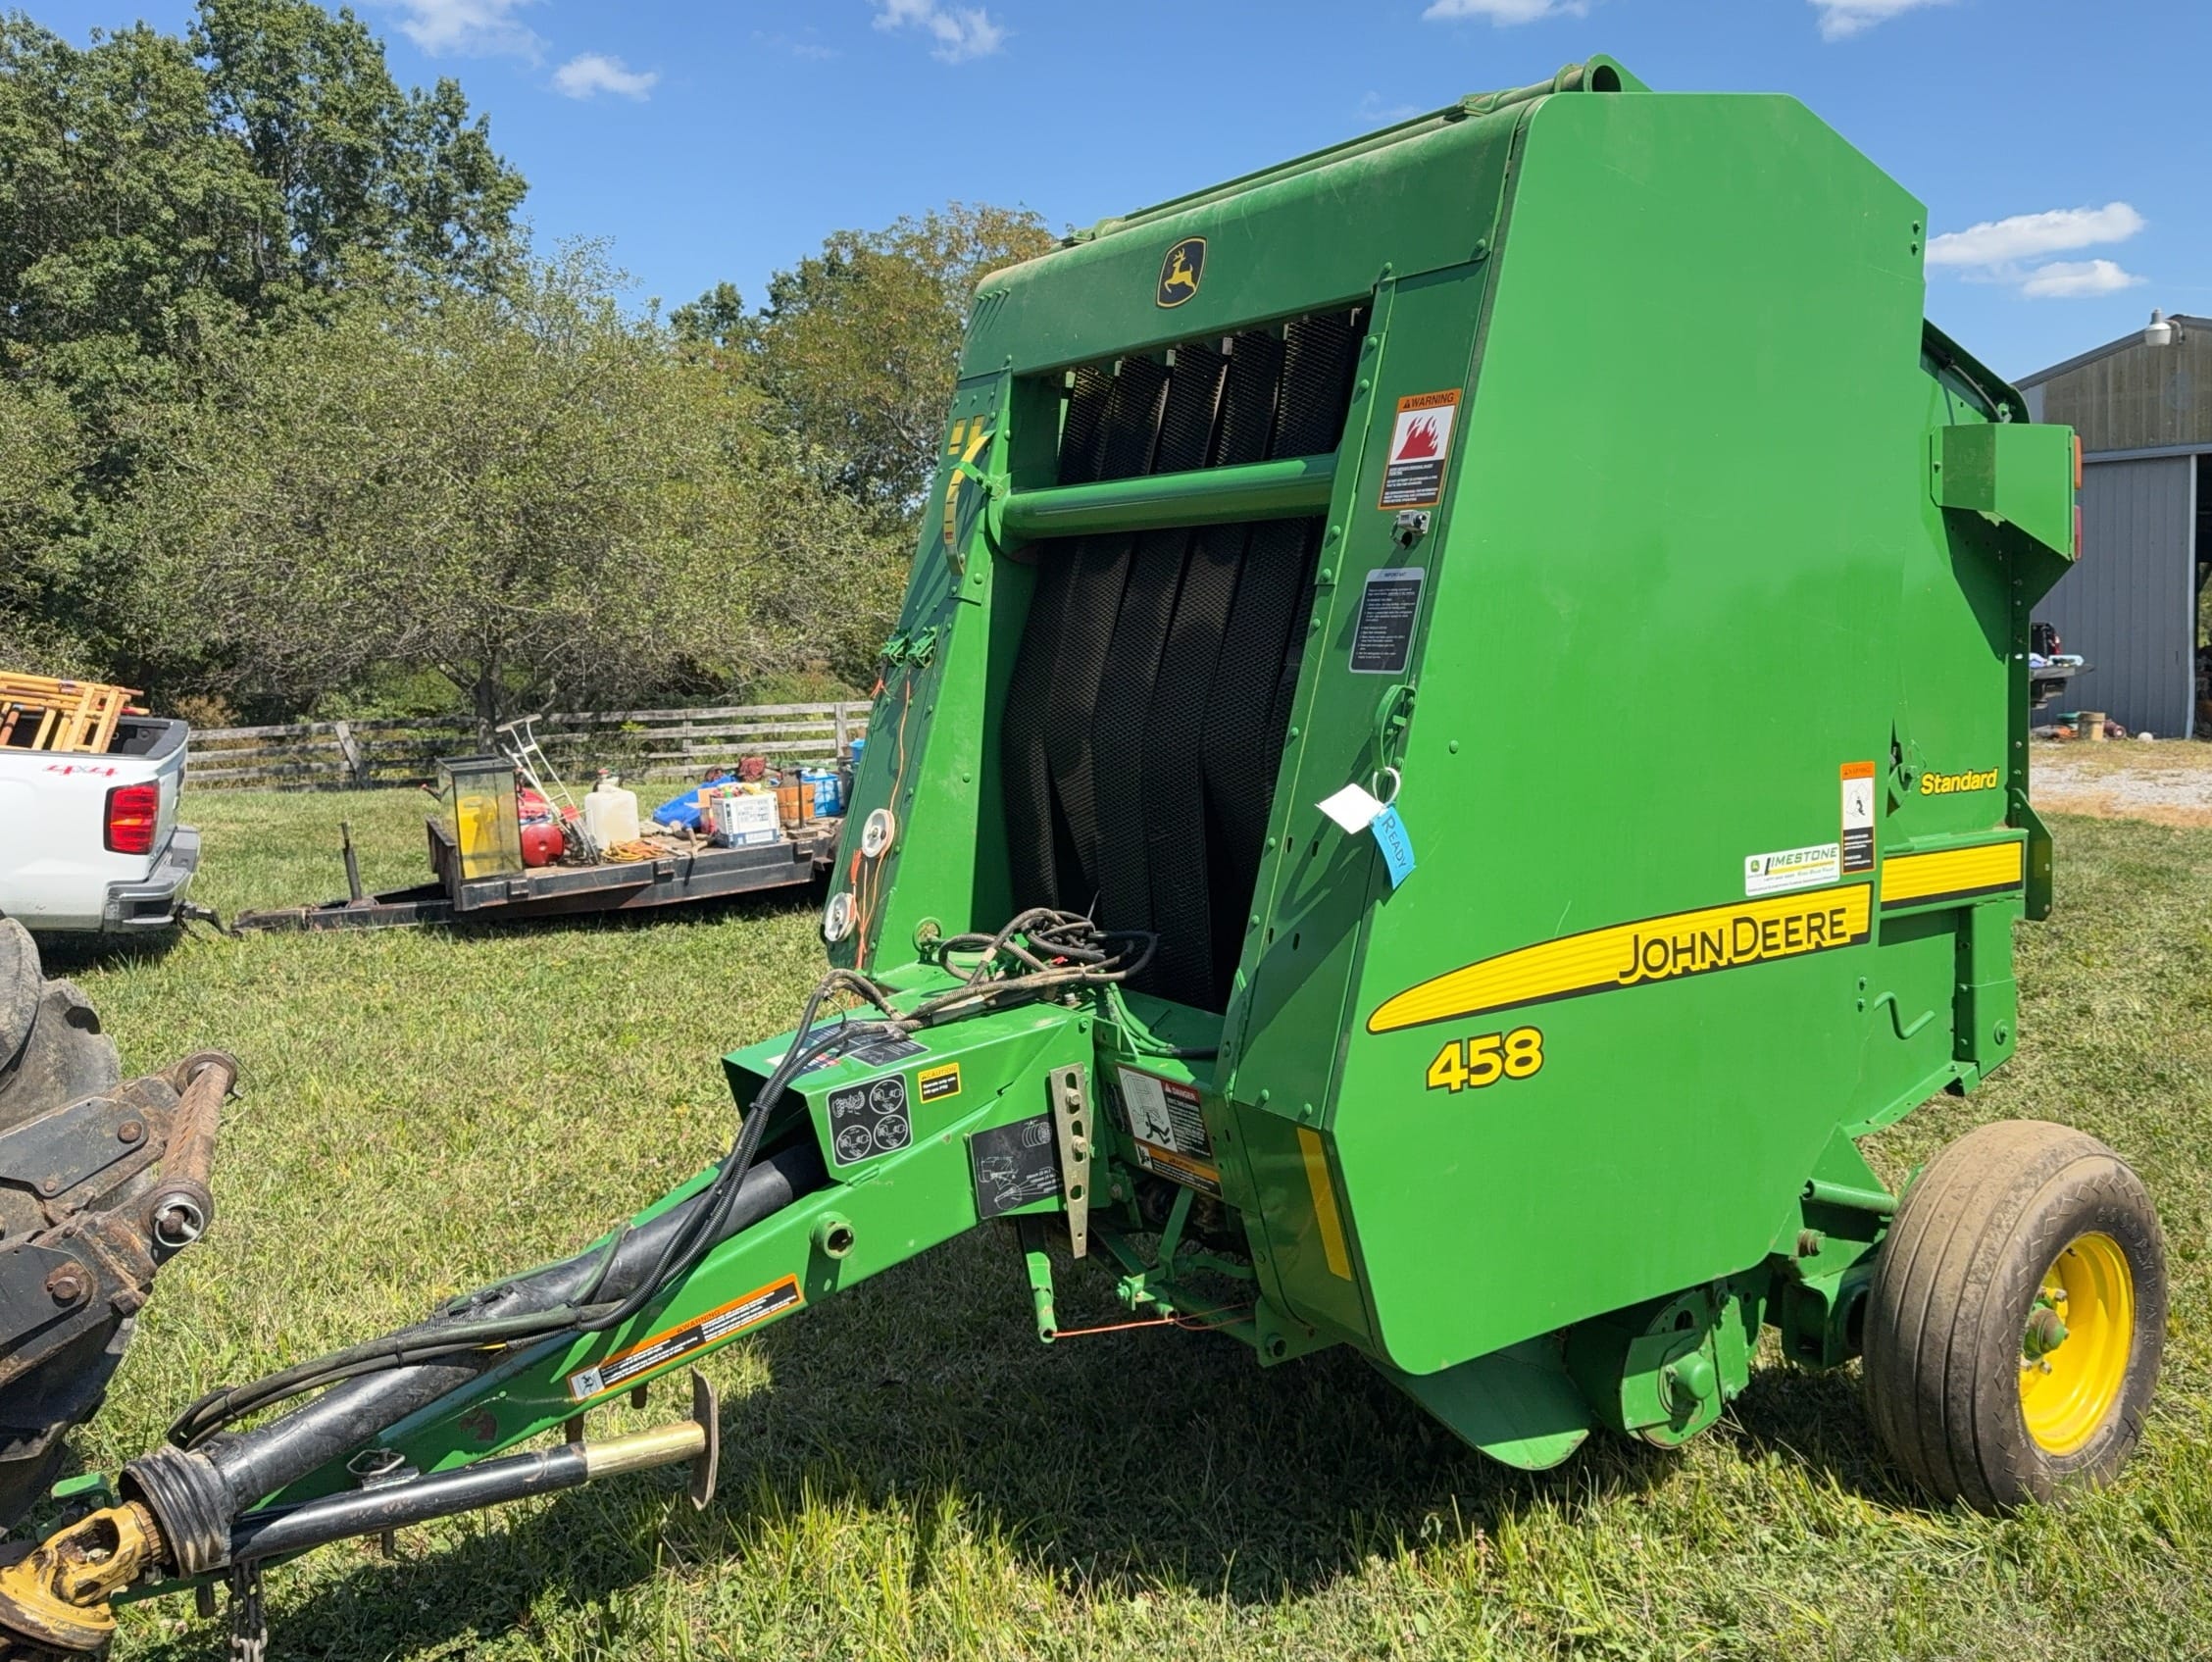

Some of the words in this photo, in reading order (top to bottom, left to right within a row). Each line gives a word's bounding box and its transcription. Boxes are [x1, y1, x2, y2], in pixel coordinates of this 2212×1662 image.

[1411, 392, 1454, 408] WARNING
[1920, 767, 2000, 796] Standard
[1382, 815, 1407, 868] READY
[1619, 926, 1724, 979] JOHN
[1733, 907, 1849, 963] DEERE
[1426, 1026, 1543, 1093] 458
[681, 1310, 721, 1331] WARNING
